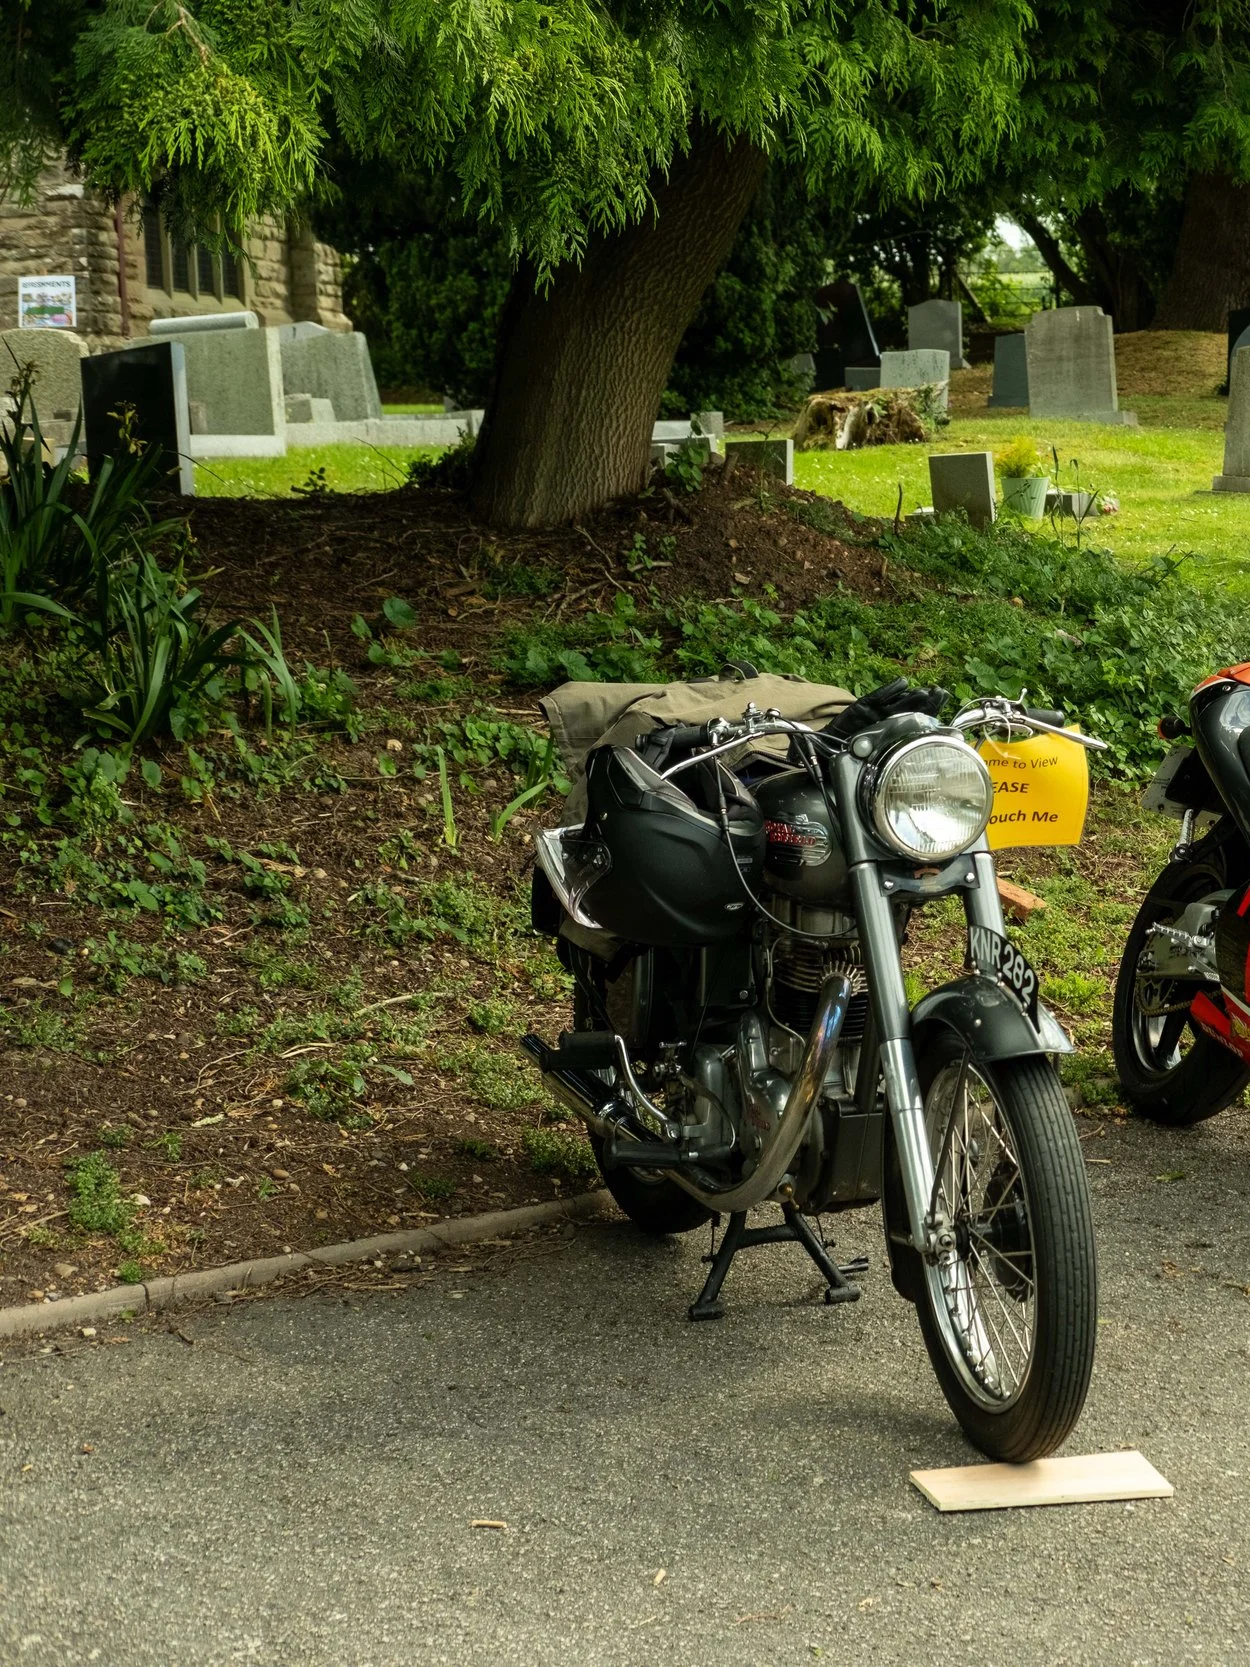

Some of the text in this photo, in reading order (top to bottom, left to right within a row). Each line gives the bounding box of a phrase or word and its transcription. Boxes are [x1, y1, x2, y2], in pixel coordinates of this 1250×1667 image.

[1013, 760, 1027, 769] to
[1030, 756, 1058, 769] View
[1031, 811, 1059, 823] Me
[969, 927, 1035, 1006] KNR 282
